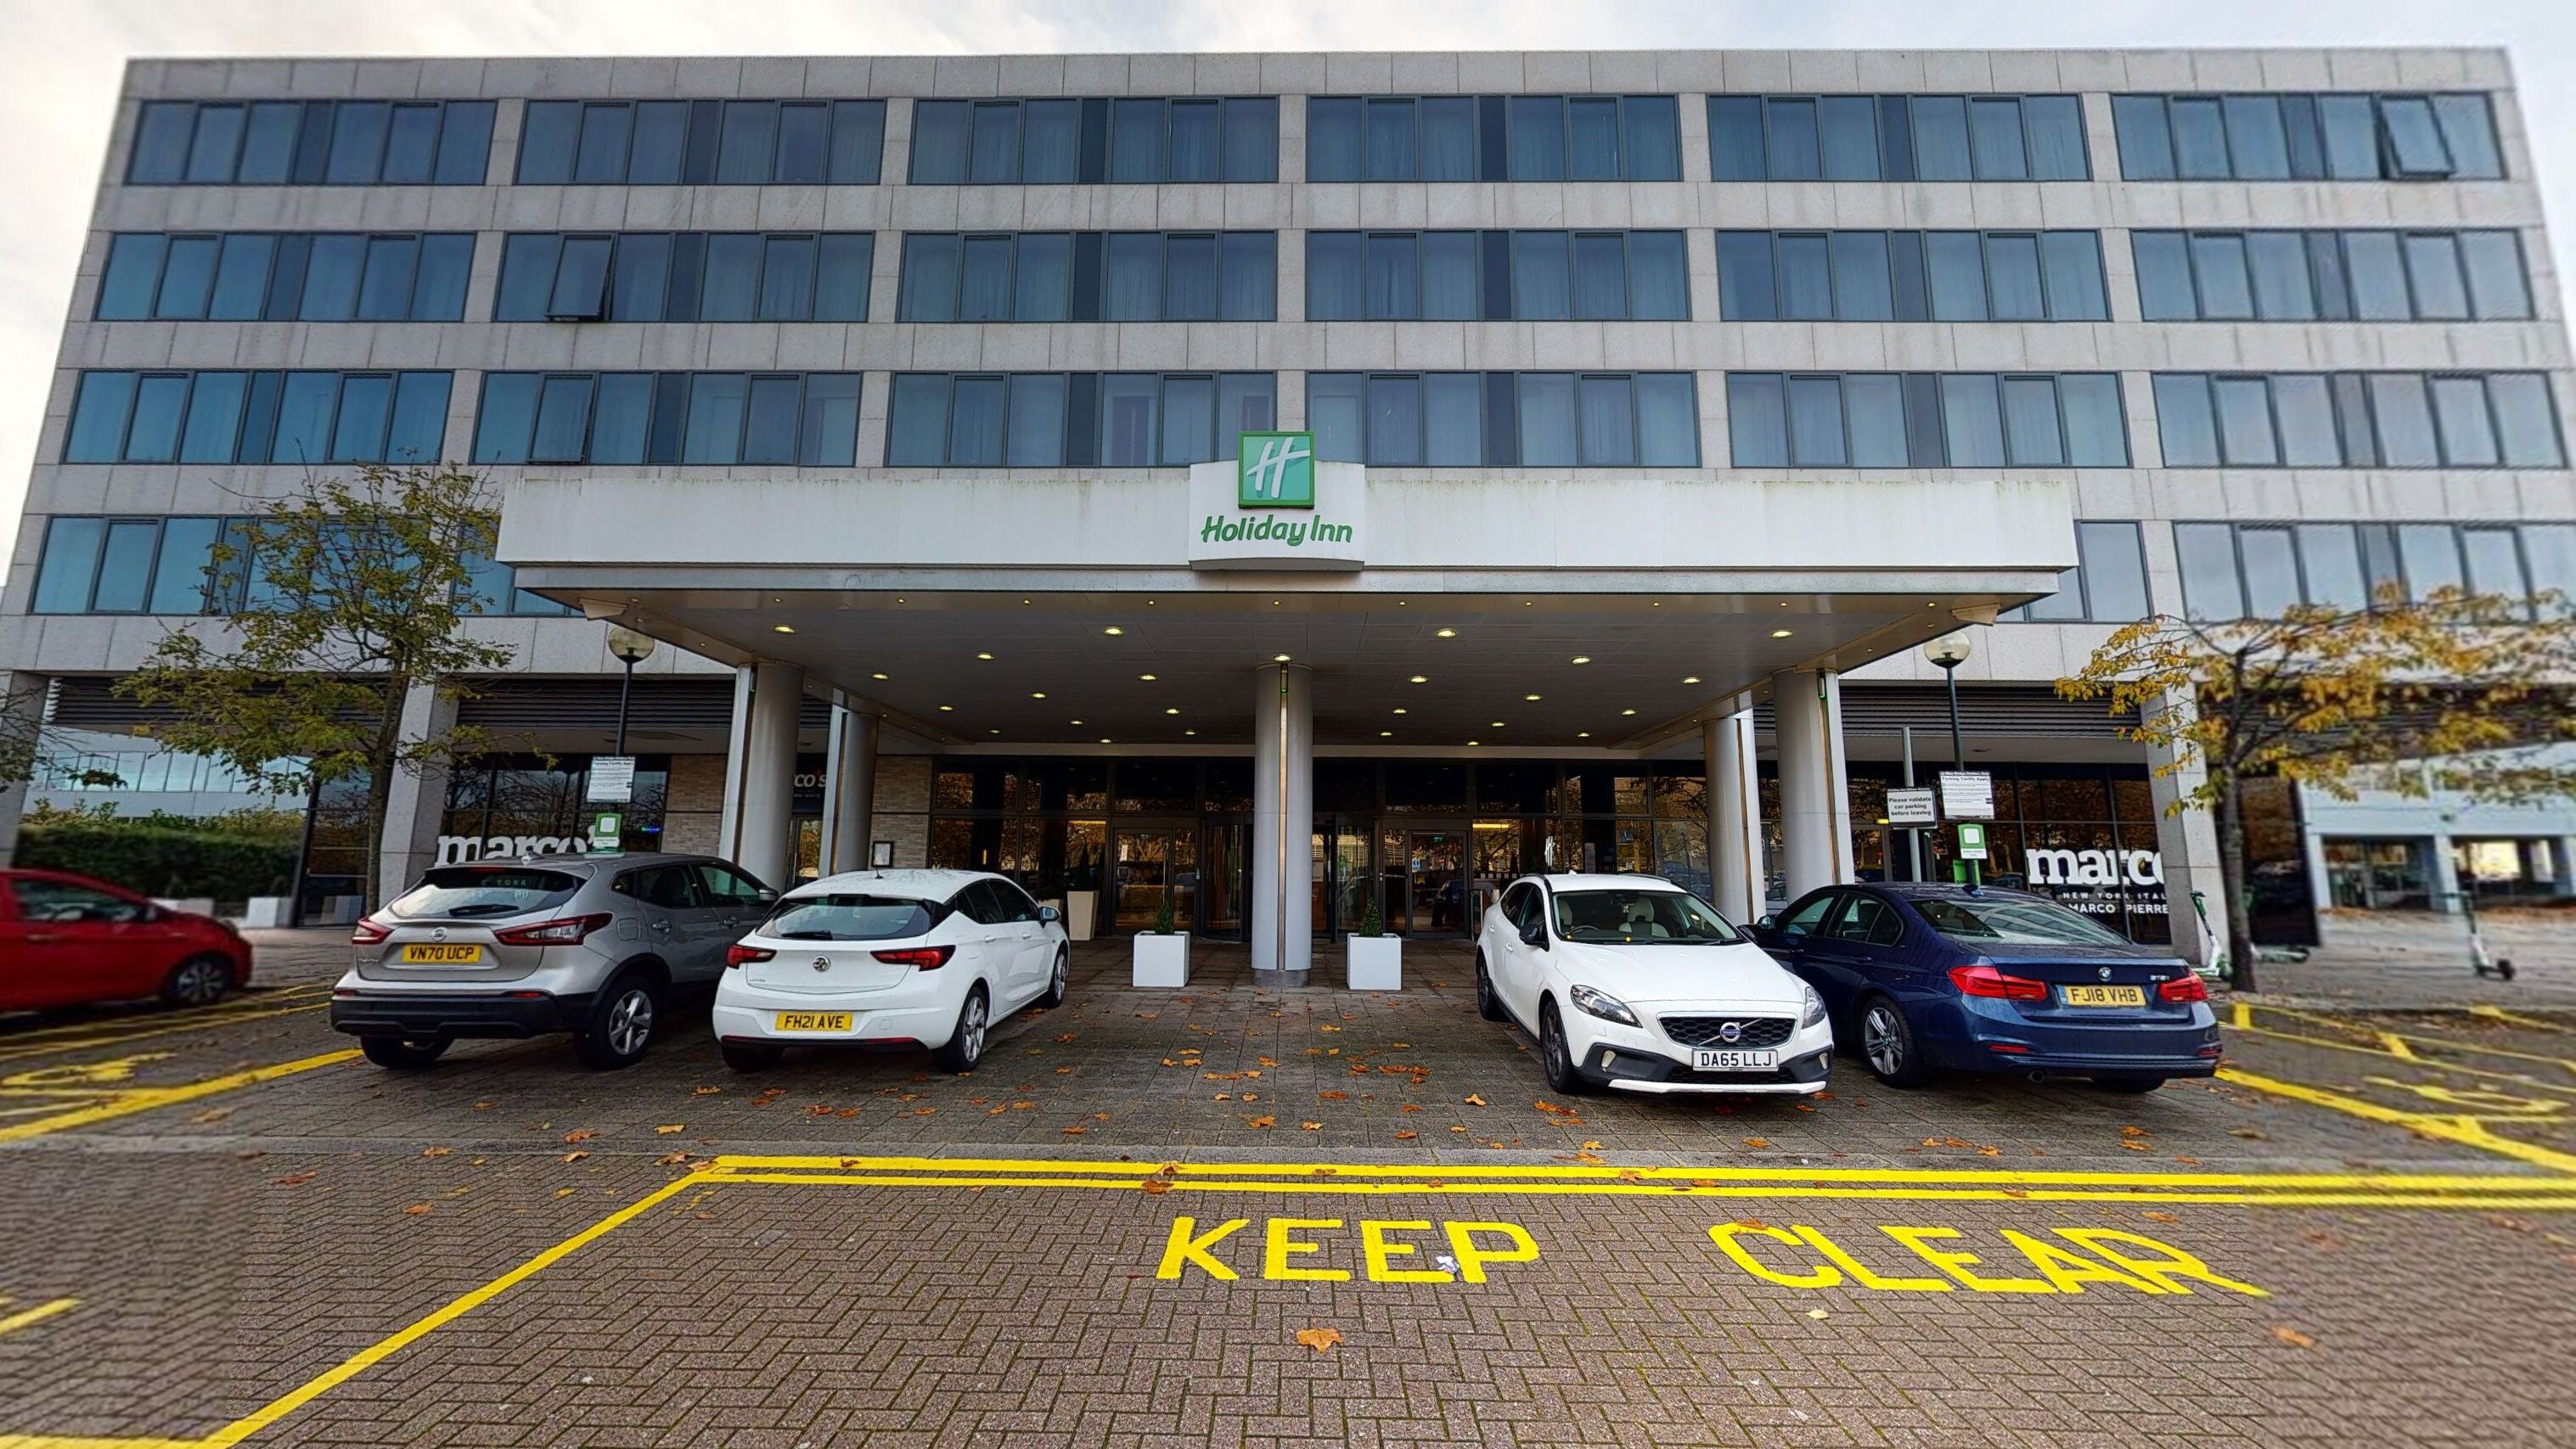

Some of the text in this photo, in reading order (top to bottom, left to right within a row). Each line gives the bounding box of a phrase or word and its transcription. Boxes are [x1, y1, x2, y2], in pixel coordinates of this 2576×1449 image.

[1201, 514, 1353, 547] Holiday Inn
[2068, 903, 2169, 914] MARCO PIERRE
[409, 946, 475, 959] VN70 UCP
[2070, 988, 2138, 1003] FJ18 VHB
[784, 1015, 845, 1029] FH21 AVE
[1701, 1053, 1772, 1066] DA65 LLJ
[1156, 1216, 2271, 1298] KEEP CLEAR
